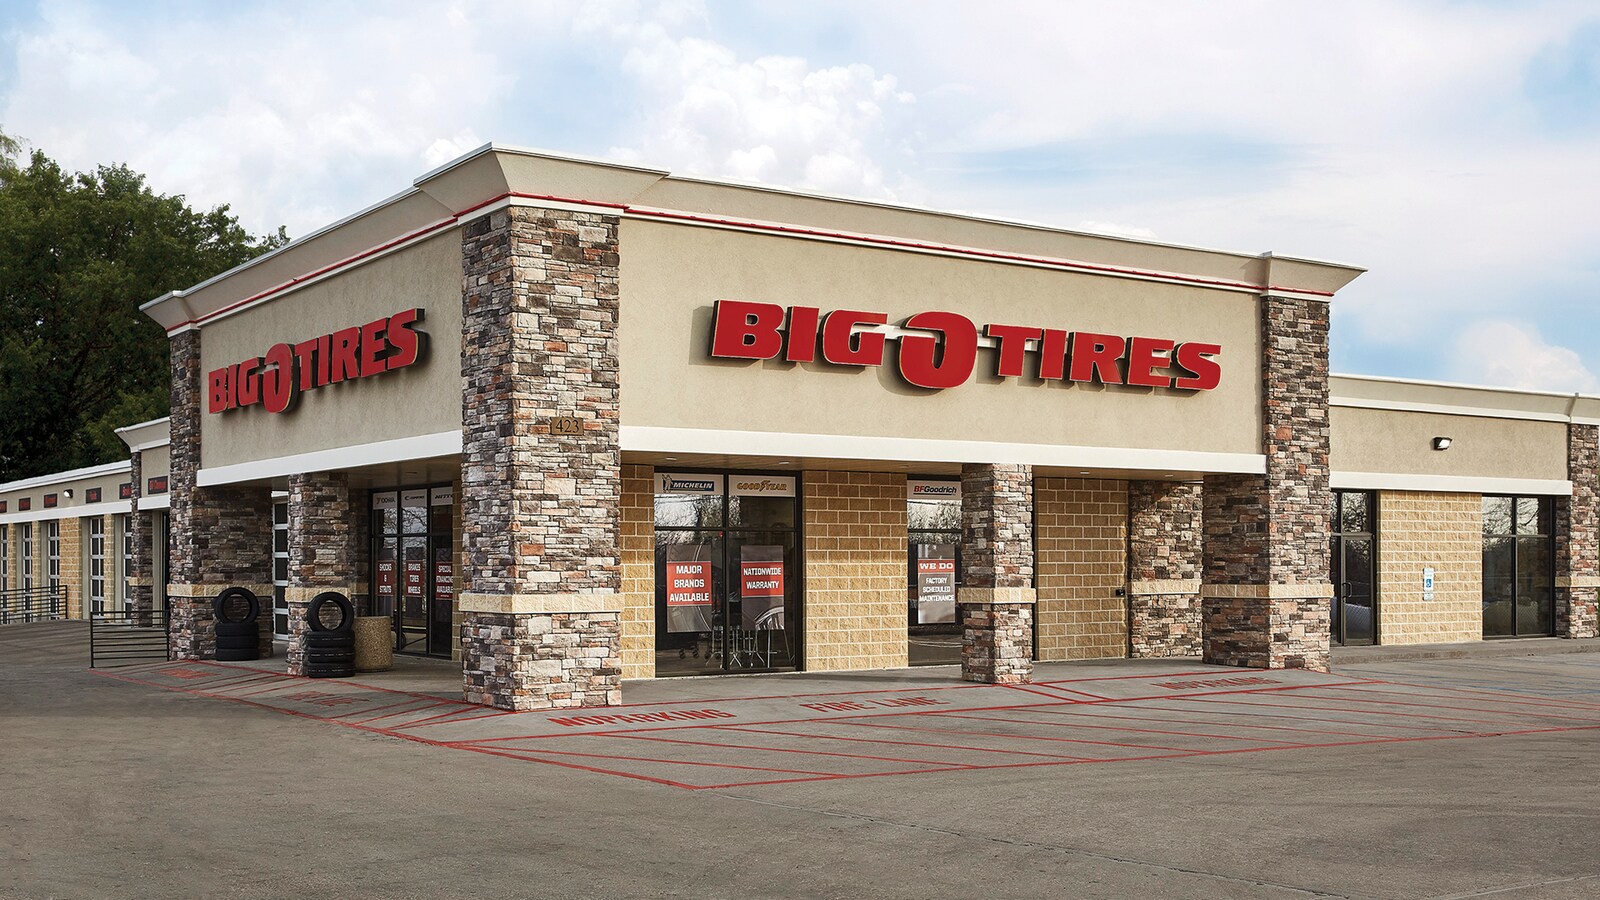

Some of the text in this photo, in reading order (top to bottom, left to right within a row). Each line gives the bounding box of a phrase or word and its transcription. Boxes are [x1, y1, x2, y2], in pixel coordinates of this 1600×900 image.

[712, 299, 1223, 392] BIG O TIRES
[208, 308, 422, 414] BIG O TIRES
[555, 419, 580, 433] 423
[672, 481, 714, 490] MICHELIN
[736, 480, 788, 492] GOODYEAR
[913, 485, 957, 493] BFGoodrich
[675, 565, 703, 574] MAJOR
[919, 562, 954, 570] WE DO
[743, 567, 782, 576] NATIONWIDE
[673, 579, 705, 588] BRANDS
[746, 580, 780, 589] WARRANTY
[922, 585, 951, 593] SCHEDULED
[669, 592, 710, 602] AVAILABLE
[919, 594, 955, 602] MAINTENANCE
[799, 696, 951, 713] FIRE LANE
